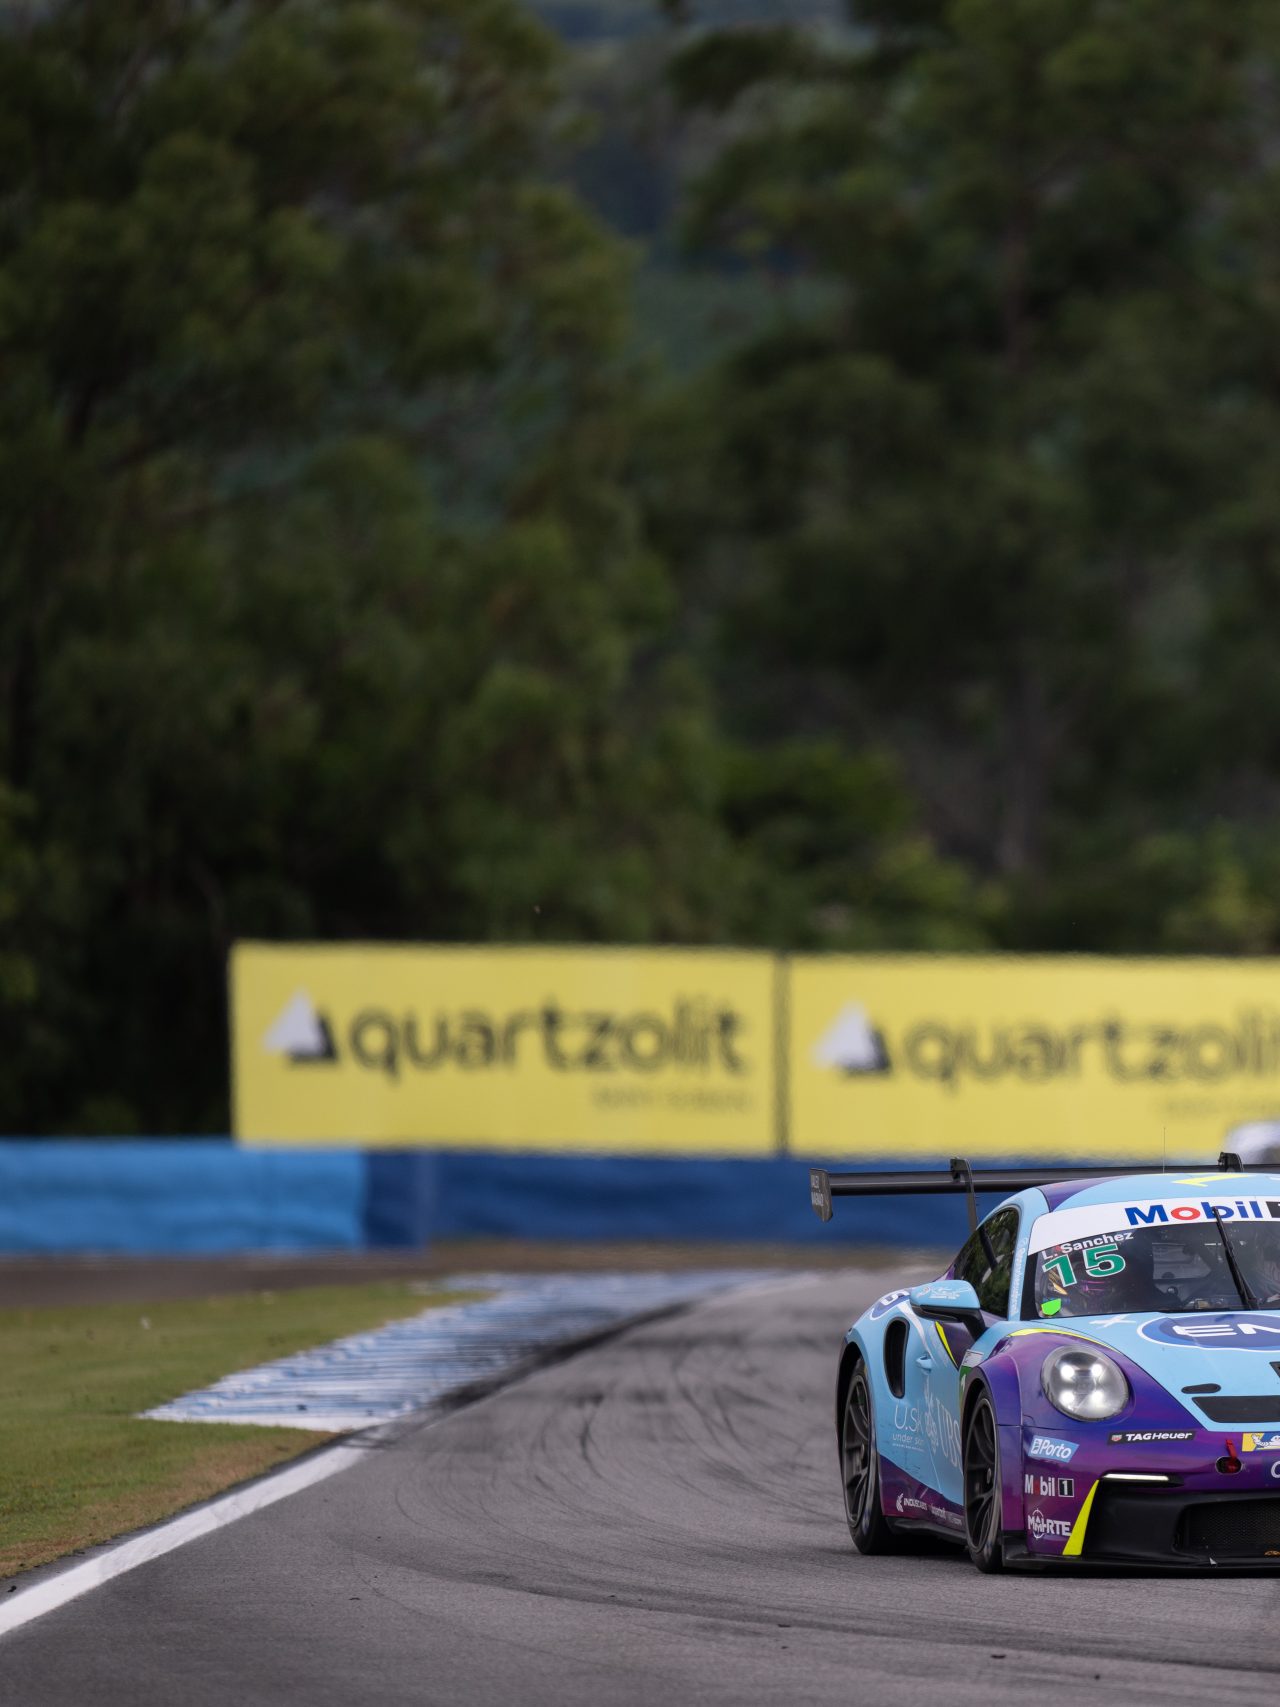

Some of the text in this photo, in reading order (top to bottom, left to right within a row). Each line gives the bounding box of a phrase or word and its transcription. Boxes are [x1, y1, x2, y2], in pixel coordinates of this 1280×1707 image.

[350, 996, 747, 1086] quartzolit
[1124, 1200, 1264, 1226] Mobil
[1041, 1232, 1134, 1260] L. Sanchez
[1041, 1243, 1126, 1288] 15
[1039, 1439, 1072, 1459] Porto
